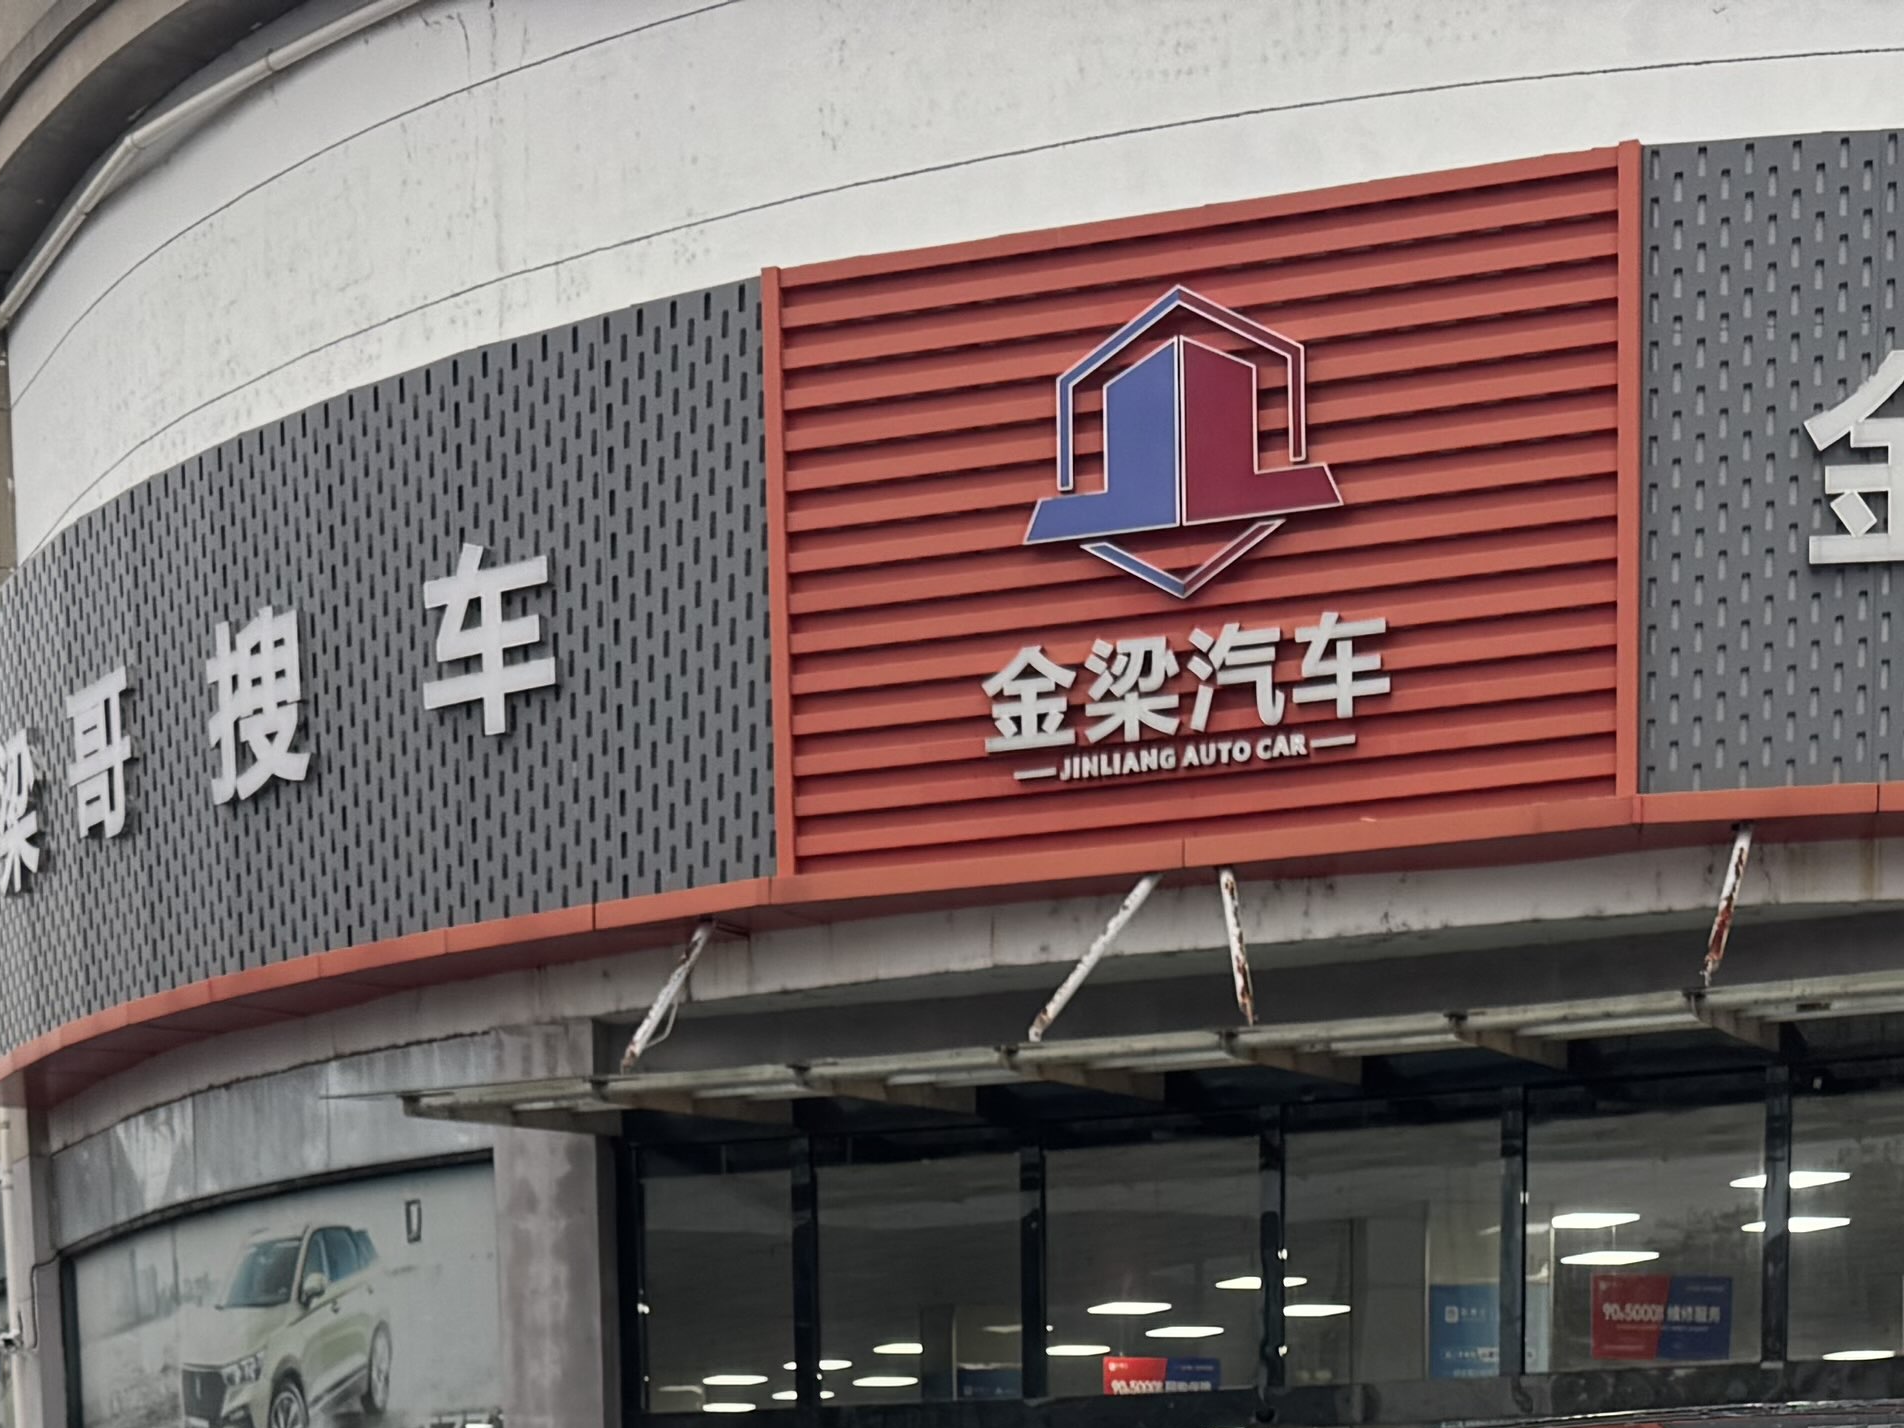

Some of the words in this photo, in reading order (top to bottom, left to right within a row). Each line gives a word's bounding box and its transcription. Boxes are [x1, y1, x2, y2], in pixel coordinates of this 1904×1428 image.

[982, 611, 1391, 753] 金梁汽车
[1059, 747, 1177, 781] JINLIANG
[1181, 739, 1252, 768] AUTO
[1255, 733, 1308, 761] CAR
